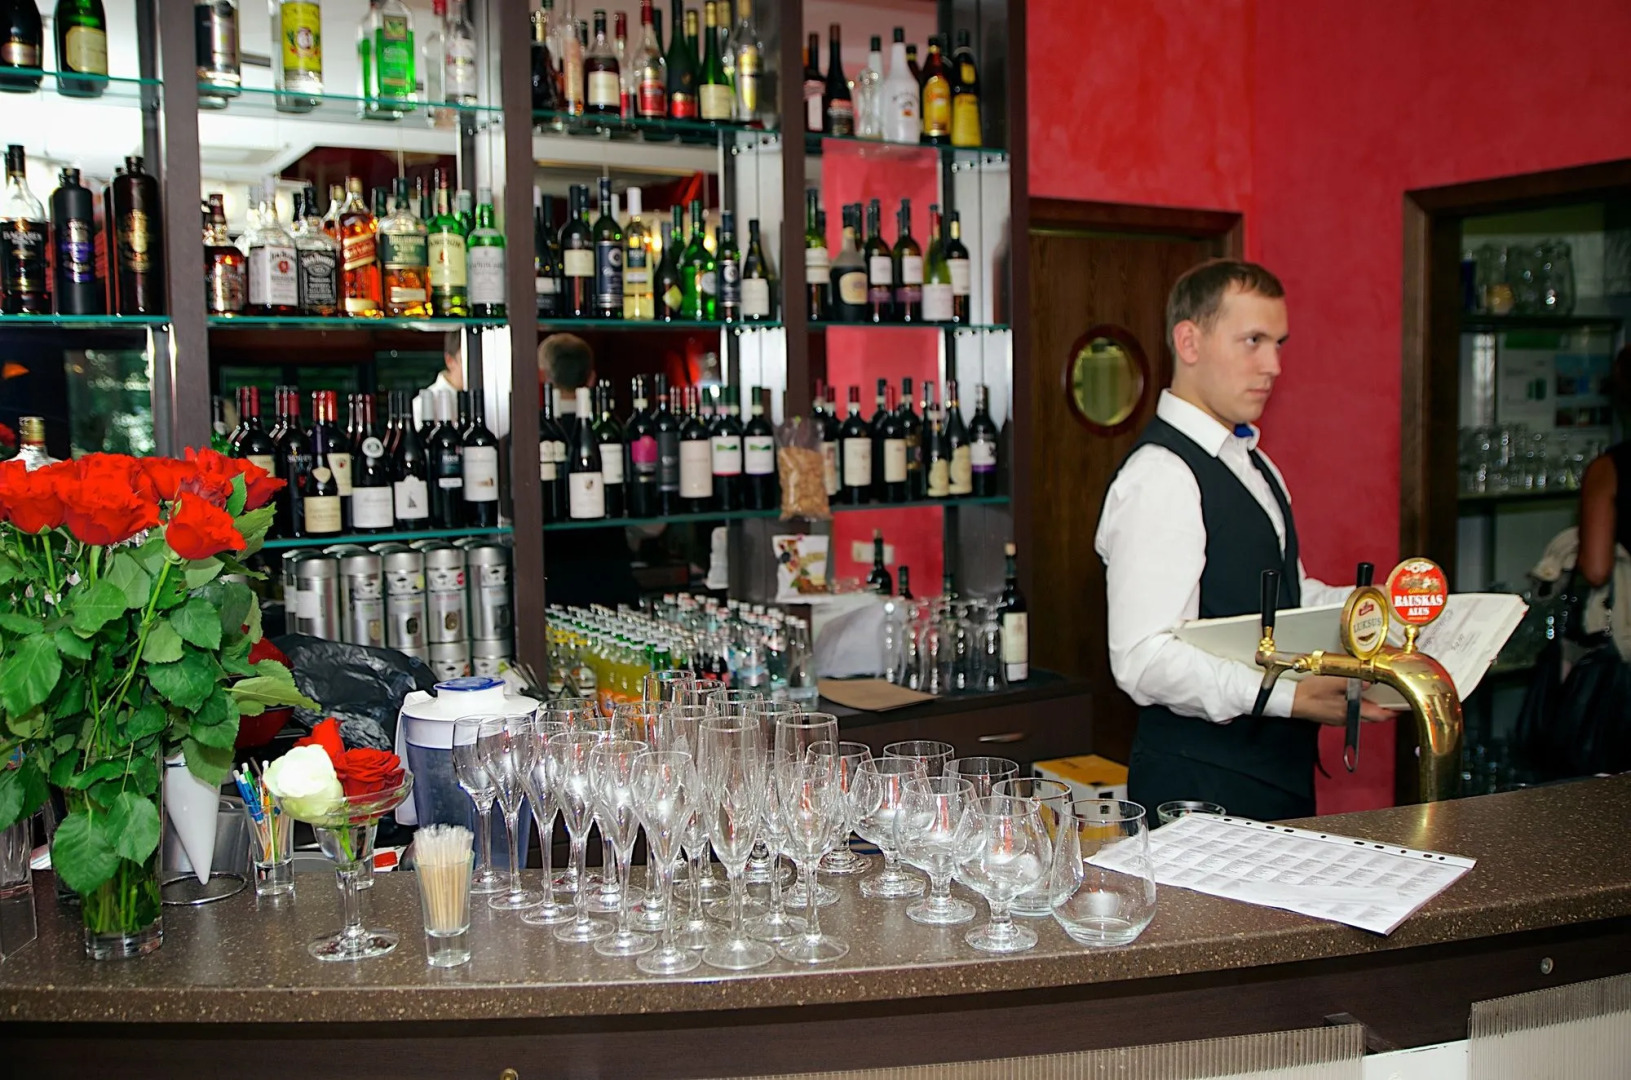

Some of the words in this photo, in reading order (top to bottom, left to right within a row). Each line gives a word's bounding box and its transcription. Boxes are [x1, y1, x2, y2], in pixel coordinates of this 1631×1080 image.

[1394, 594, 1443, 607] BAUSKAS
[1407, 607, 1430, 616] ALUS
[1353, 617, 1382, 633] LUKSUS
